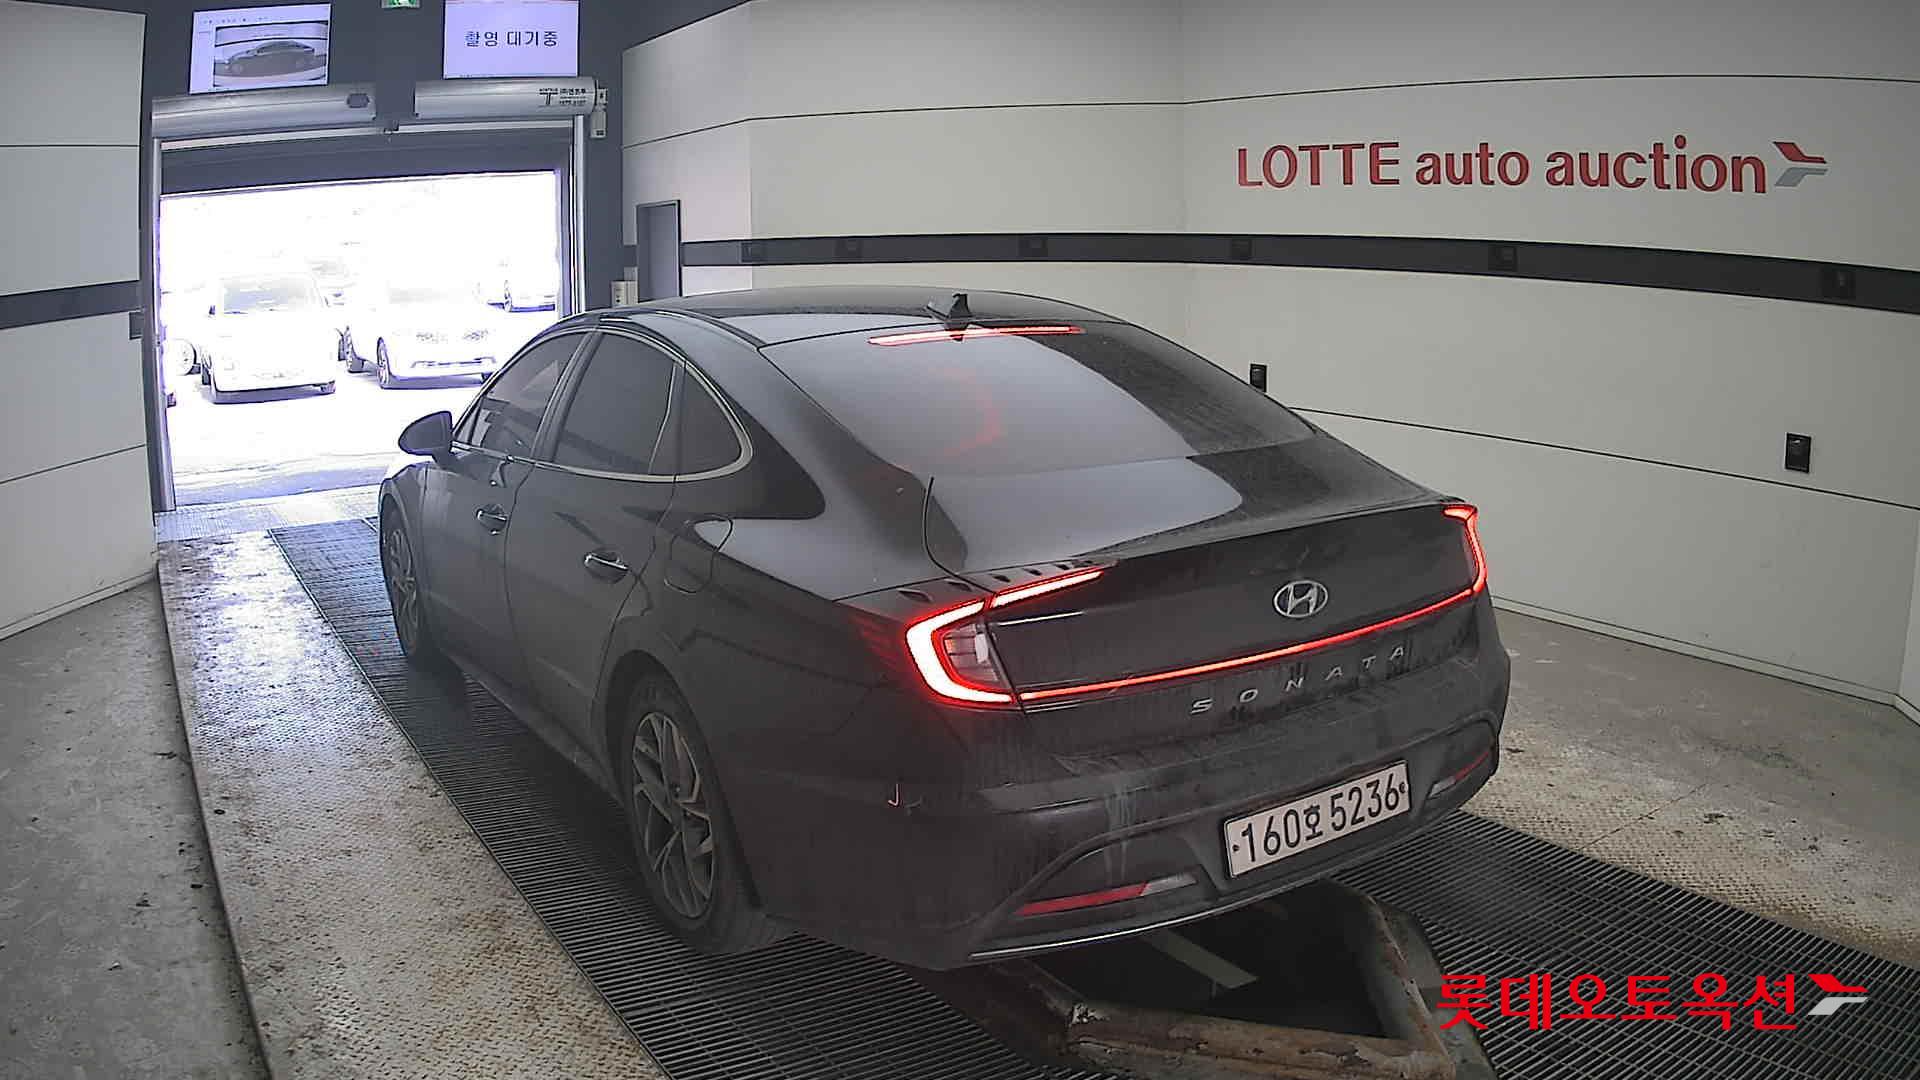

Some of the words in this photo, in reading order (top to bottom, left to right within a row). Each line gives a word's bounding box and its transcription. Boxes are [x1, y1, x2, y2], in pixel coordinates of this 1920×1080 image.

[506, 31, 558, 47] 대기중
[1237, 142, 1400, 188] LOTTE
[1415, 142, 1530, 186] auto
[1546, 134, 1767, 194] auction
[1191, 646, 1404, 714] SONATA
[1241, 804, 1323, 863] 160호
[1329, 773, 1400, 832] 5236
